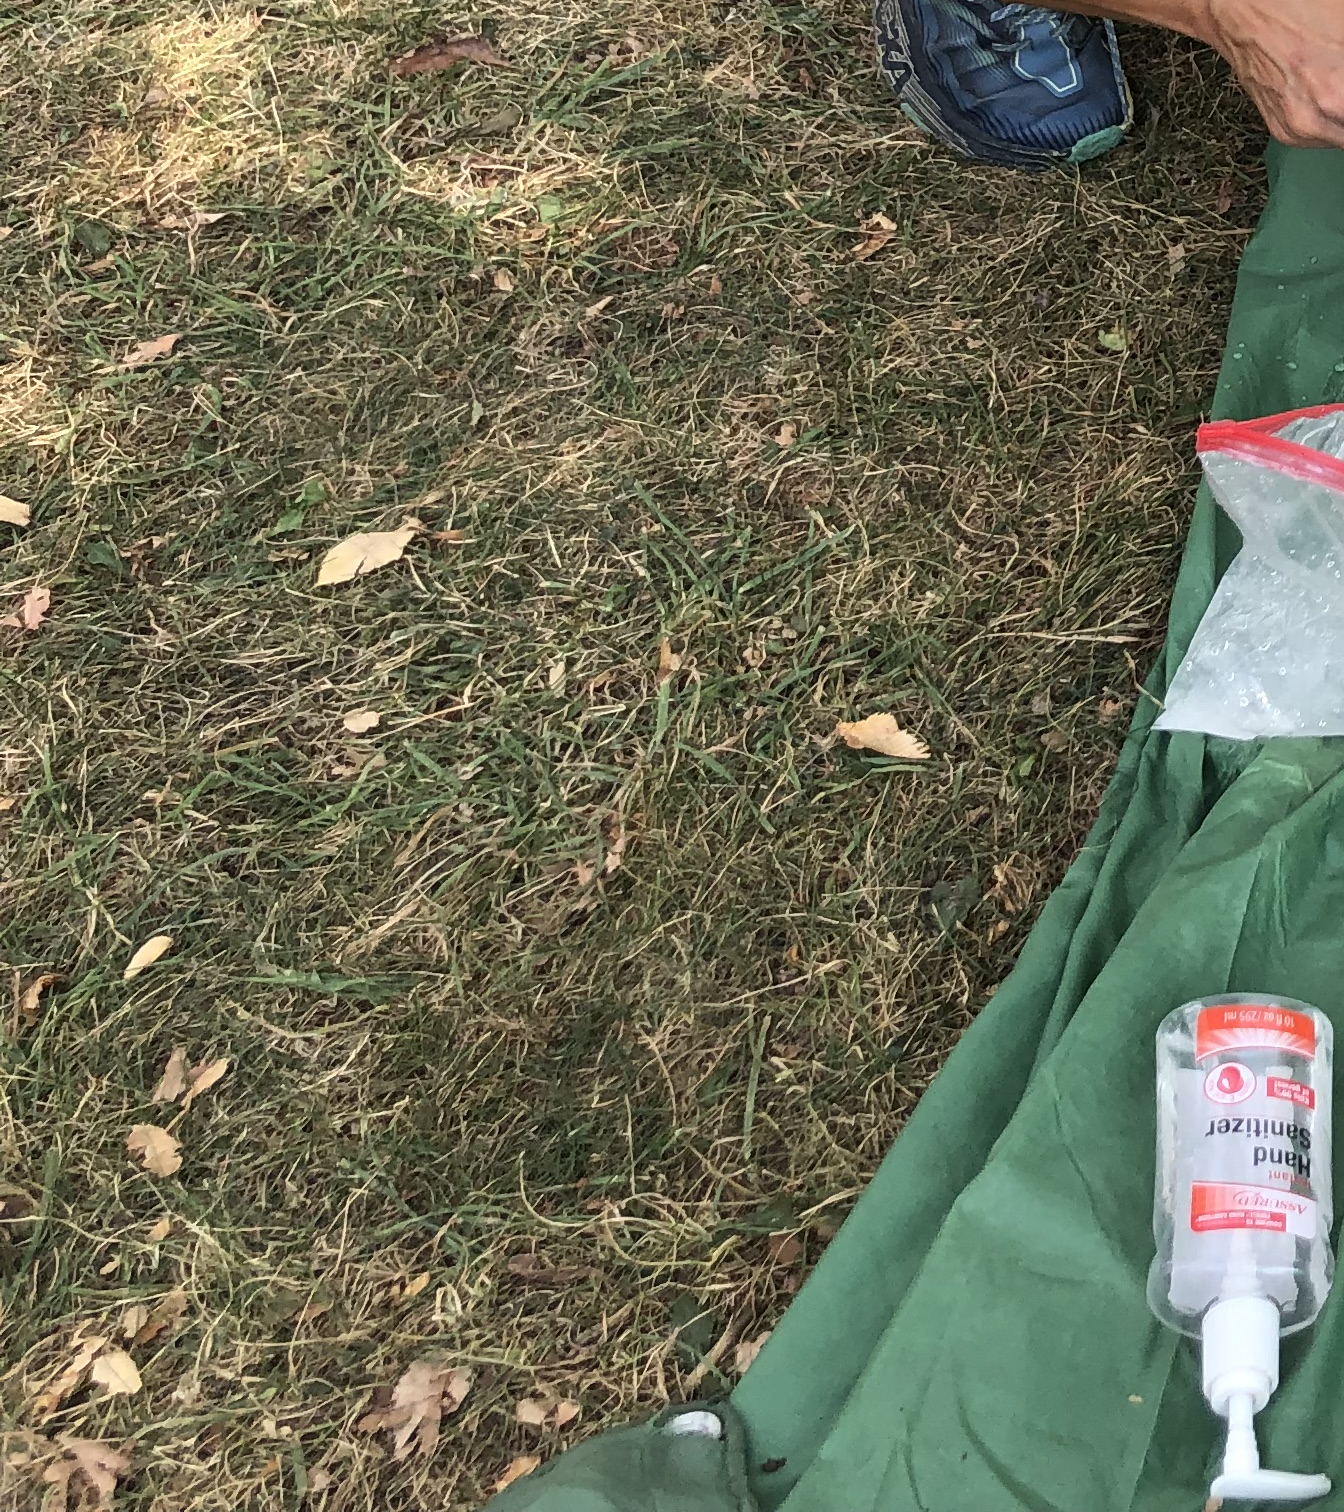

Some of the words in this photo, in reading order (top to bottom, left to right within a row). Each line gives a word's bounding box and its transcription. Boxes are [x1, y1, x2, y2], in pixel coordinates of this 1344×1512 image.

[1224, 1011, 1237, 1023] ml
[1263, 1012, 1274, 1020] oz
[1276, 1013, 1283, 1025] fl
[1284, 1017, 1295, 1027] 10
[1205, 1117, 1311, 1150] Sanitizer
[1253, 1146, 1311, 1178] Hand
